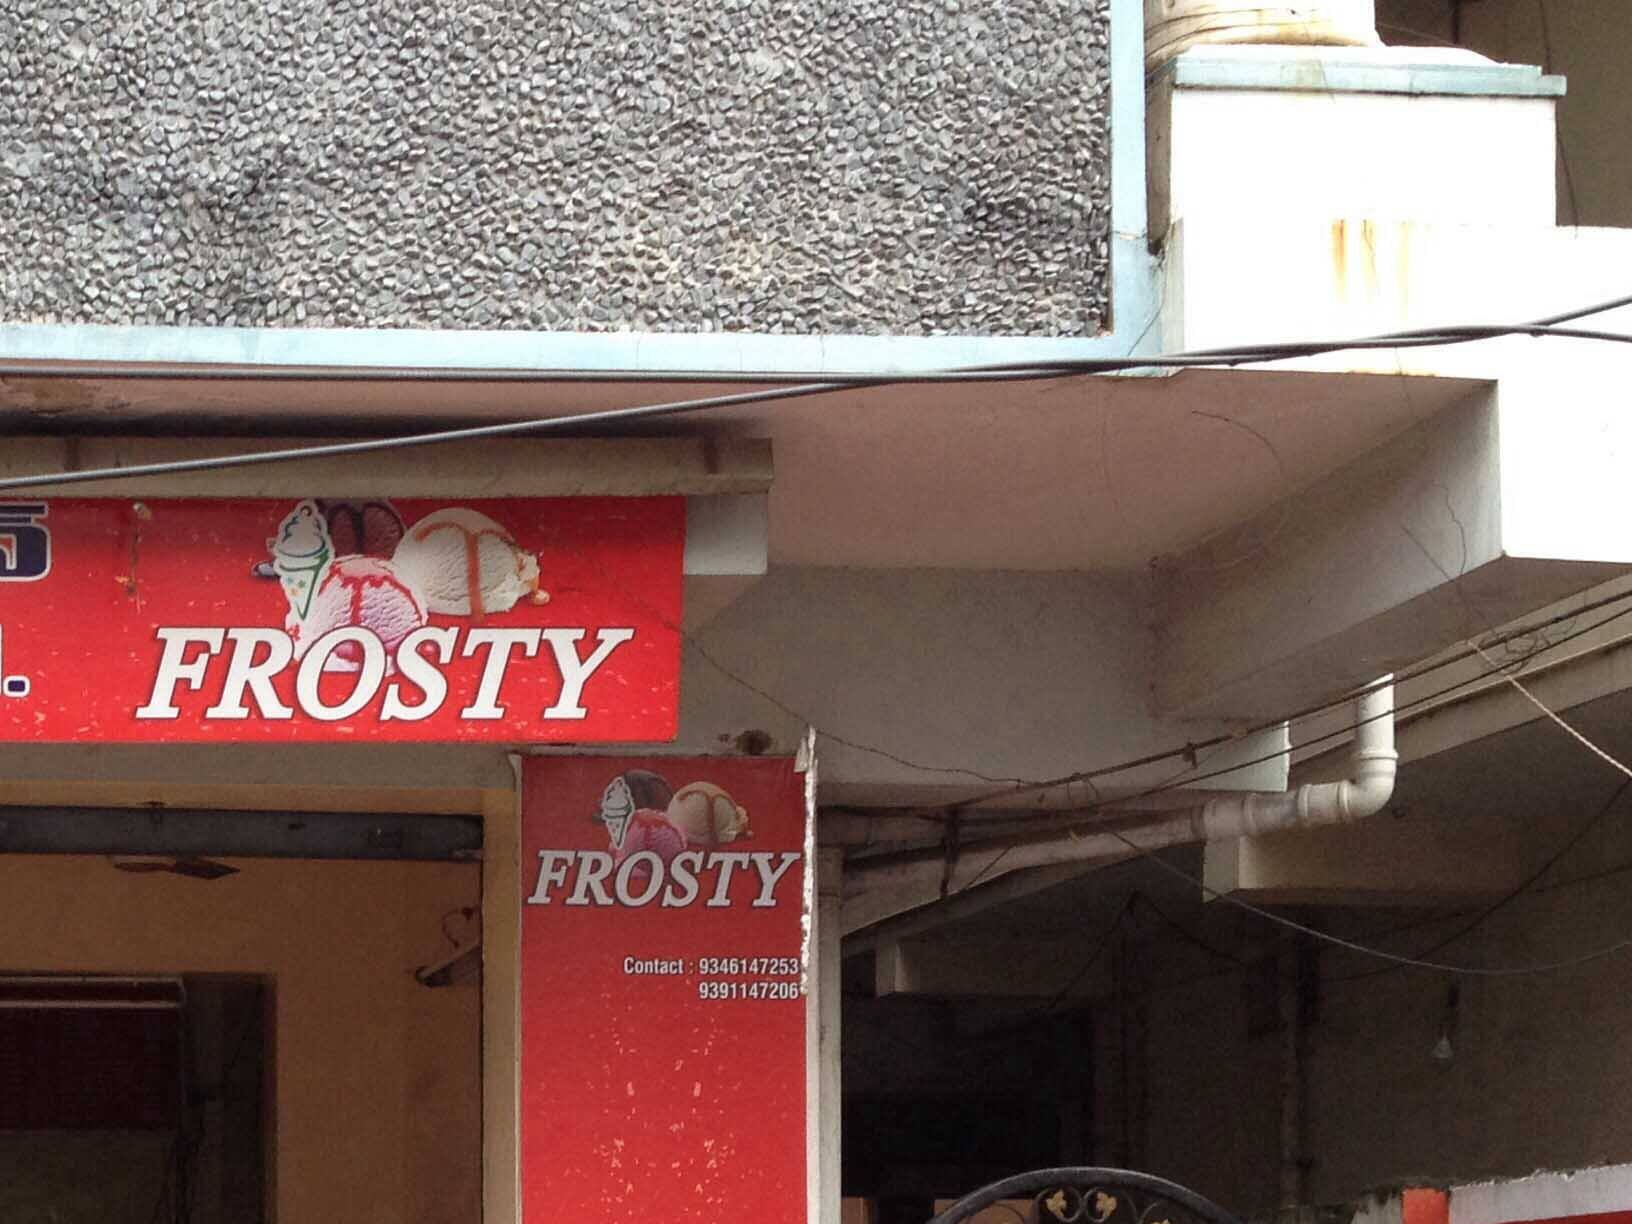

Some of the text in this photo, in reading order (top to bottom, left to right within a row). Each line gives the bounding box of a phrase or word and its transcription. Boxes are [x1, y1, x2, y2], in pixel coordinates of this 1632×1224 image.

[135, 626, 635, 722] FROSTY
[527, 850, 801, 907] FROSTY
[623, 957, 684, 975] Contact
[699, 958, 799, 976] 9346147253
[699, 982, 799, 1000] 9391147206
